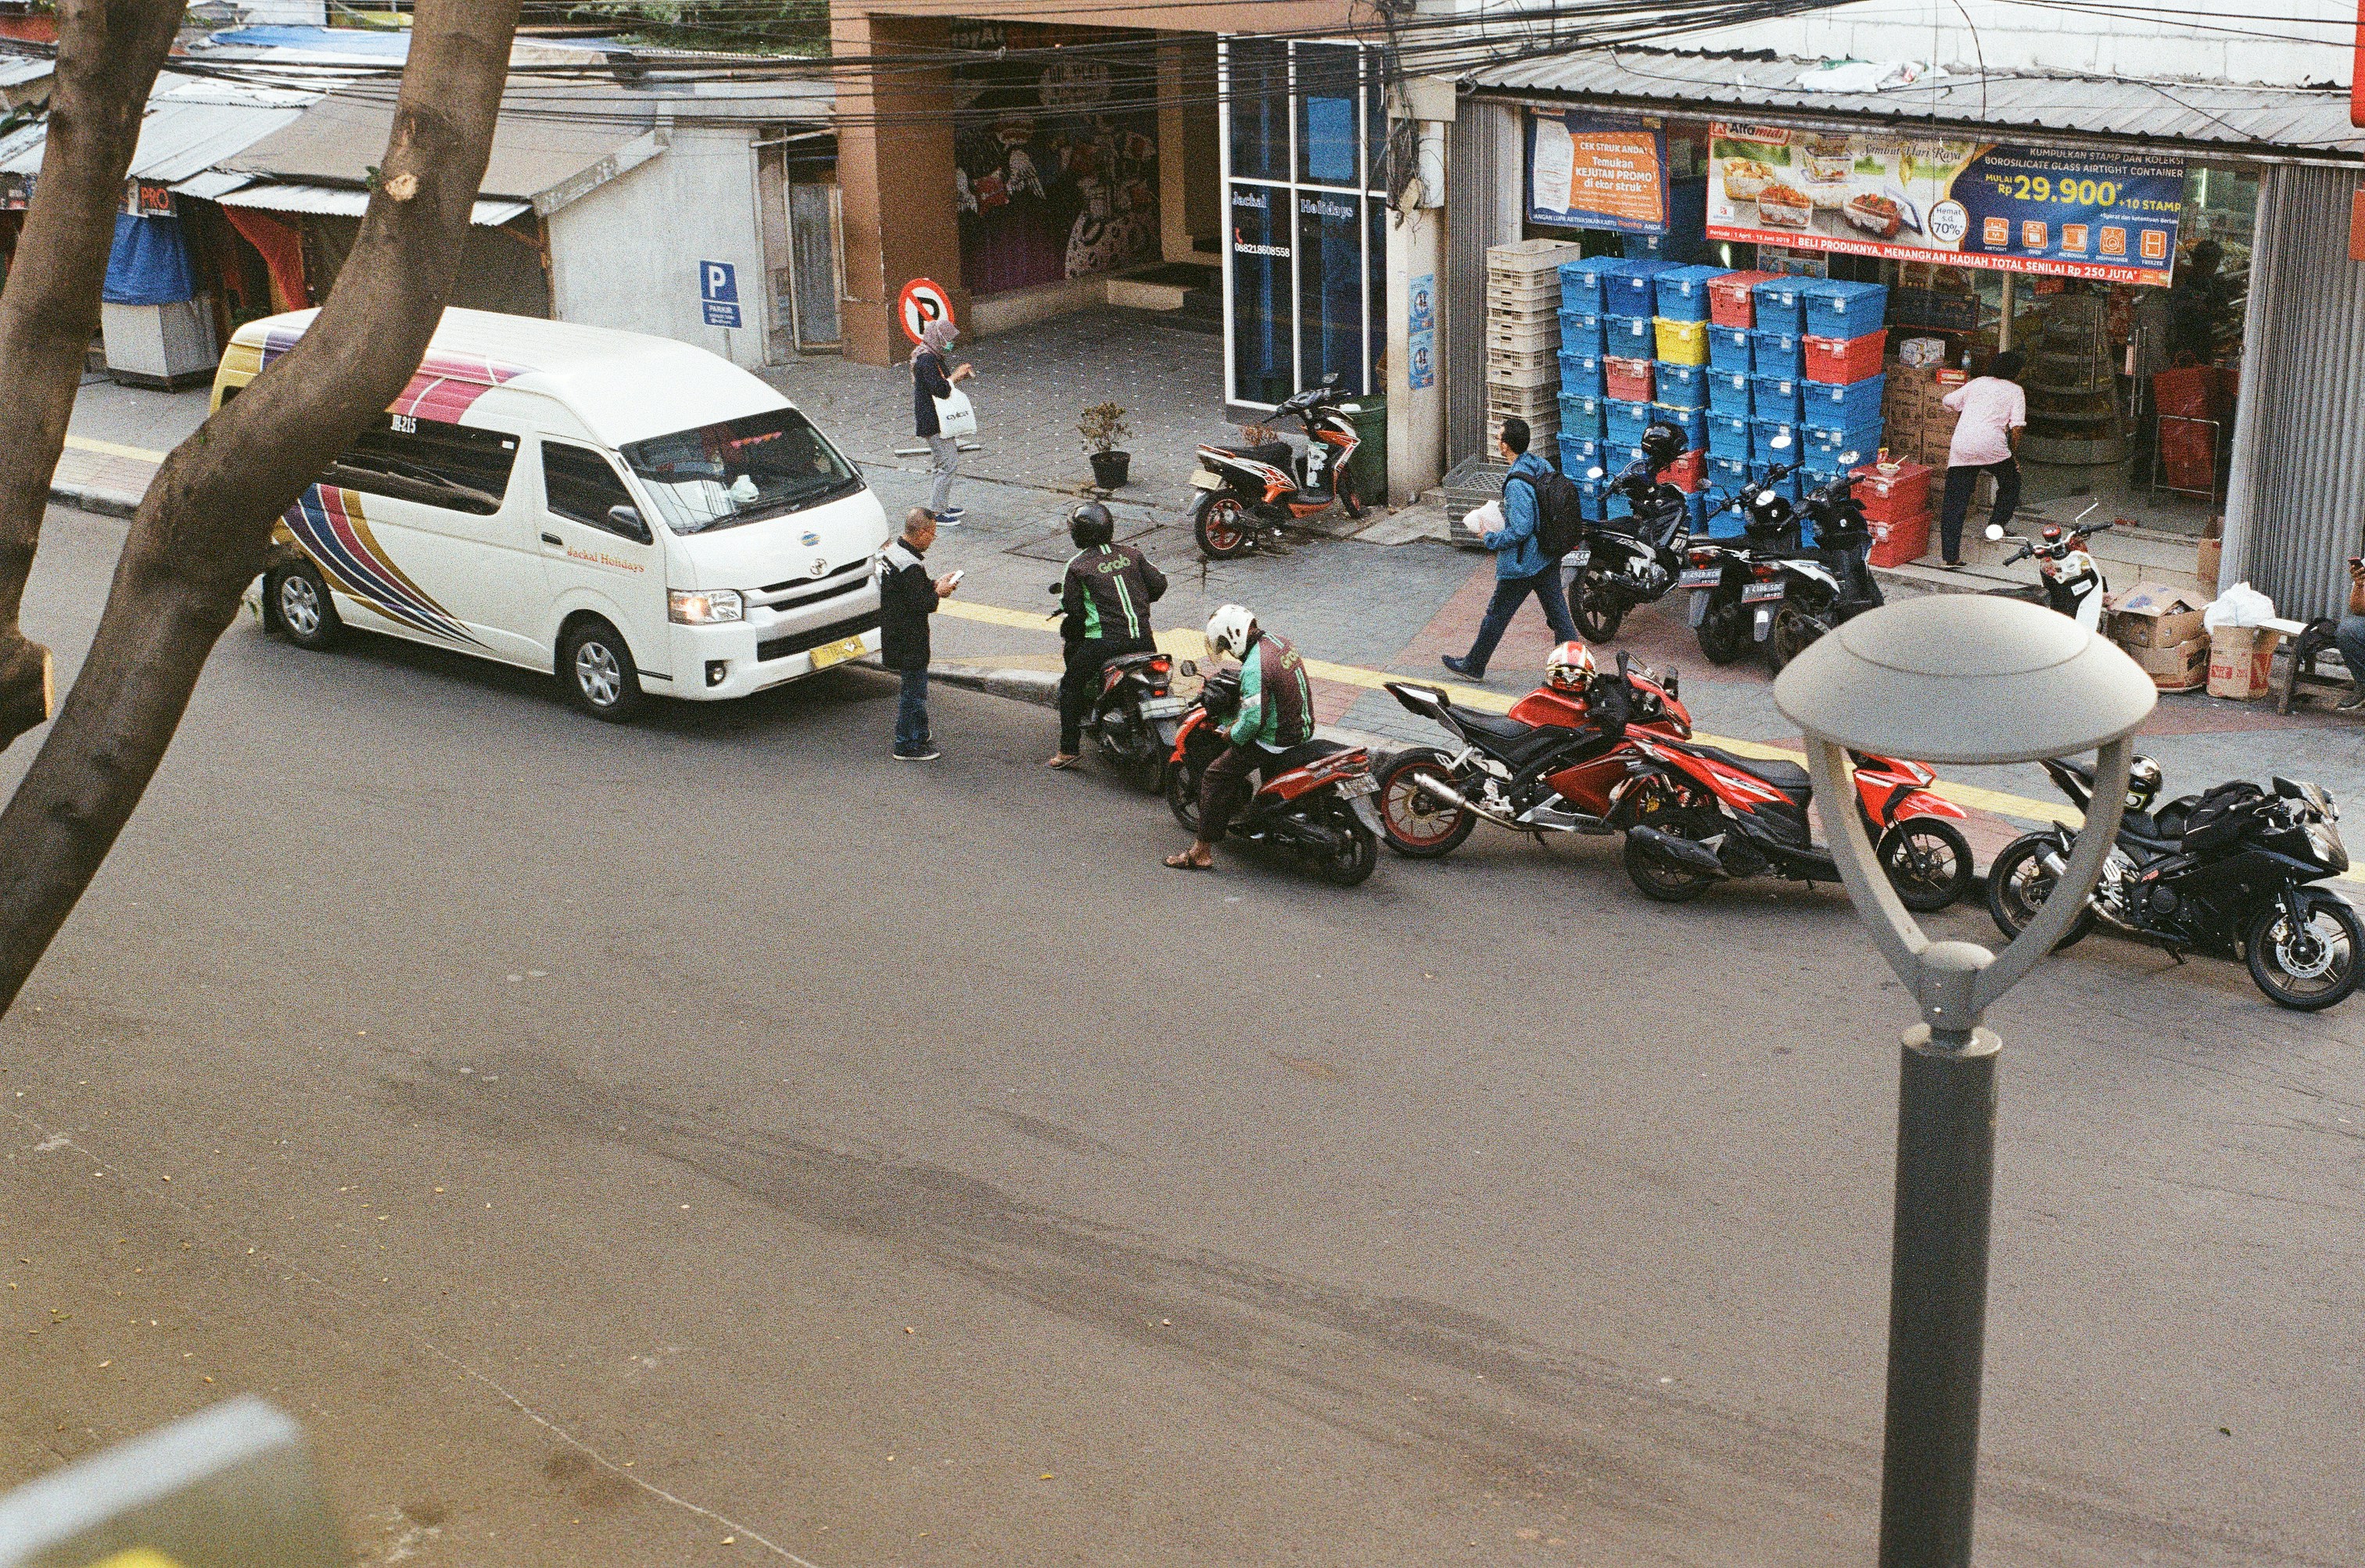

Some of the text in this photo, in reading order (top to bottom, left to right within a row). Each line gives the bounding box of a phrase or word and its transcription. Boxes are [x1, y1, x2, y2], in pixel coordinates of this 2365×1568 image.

[1580, 142, 1595, 152] CEK
[1596, 143, 1620, 152] STRUK
[1592, 156, 1635, 170] Temukan
[2029, 148, 2184, 165] KUMPULKAN STAMP DAN KOLEKSI
[1576, 167, 1653, 182] KEJUTAN PROMO
[1985, 156, 2184, 178] BOROSILICATE GLASS AIRTIGHT CONTAINER
[1584, 178, 1594, 188] di
[1595, 180, 1613, 189] ekor
[1985, 174, 2013, 185] MULAI
[1998, 183, 2013, 197] Rp
[140, 187, 170, 210] PRO
[1232, 191, 1354, 219] Jackal Holidays
[2119, 199, 2183, 213] +10 STAMP
[1936, 207, 1961, 216] Hemat
[1798, 238, 1818, 249] BELI
[1821, 240, 1882, 257] PRODUKNYA,
[1884, 247, 1947, 262] MENANGKAN
[1950, 254, 1988, 267] HADIAH
[1992, 258, 2022, 271] TOTAL
[2026, 262, 2065, 274] SENILAI
[2068, 264, 2081, 277] Rp
[2084, 267, 2105, 278] 250
[709, 266, 726, 298] P
[566, 546, 644, 572] Jackal Holidays
[1097, 554, 1131, 574] Grab
